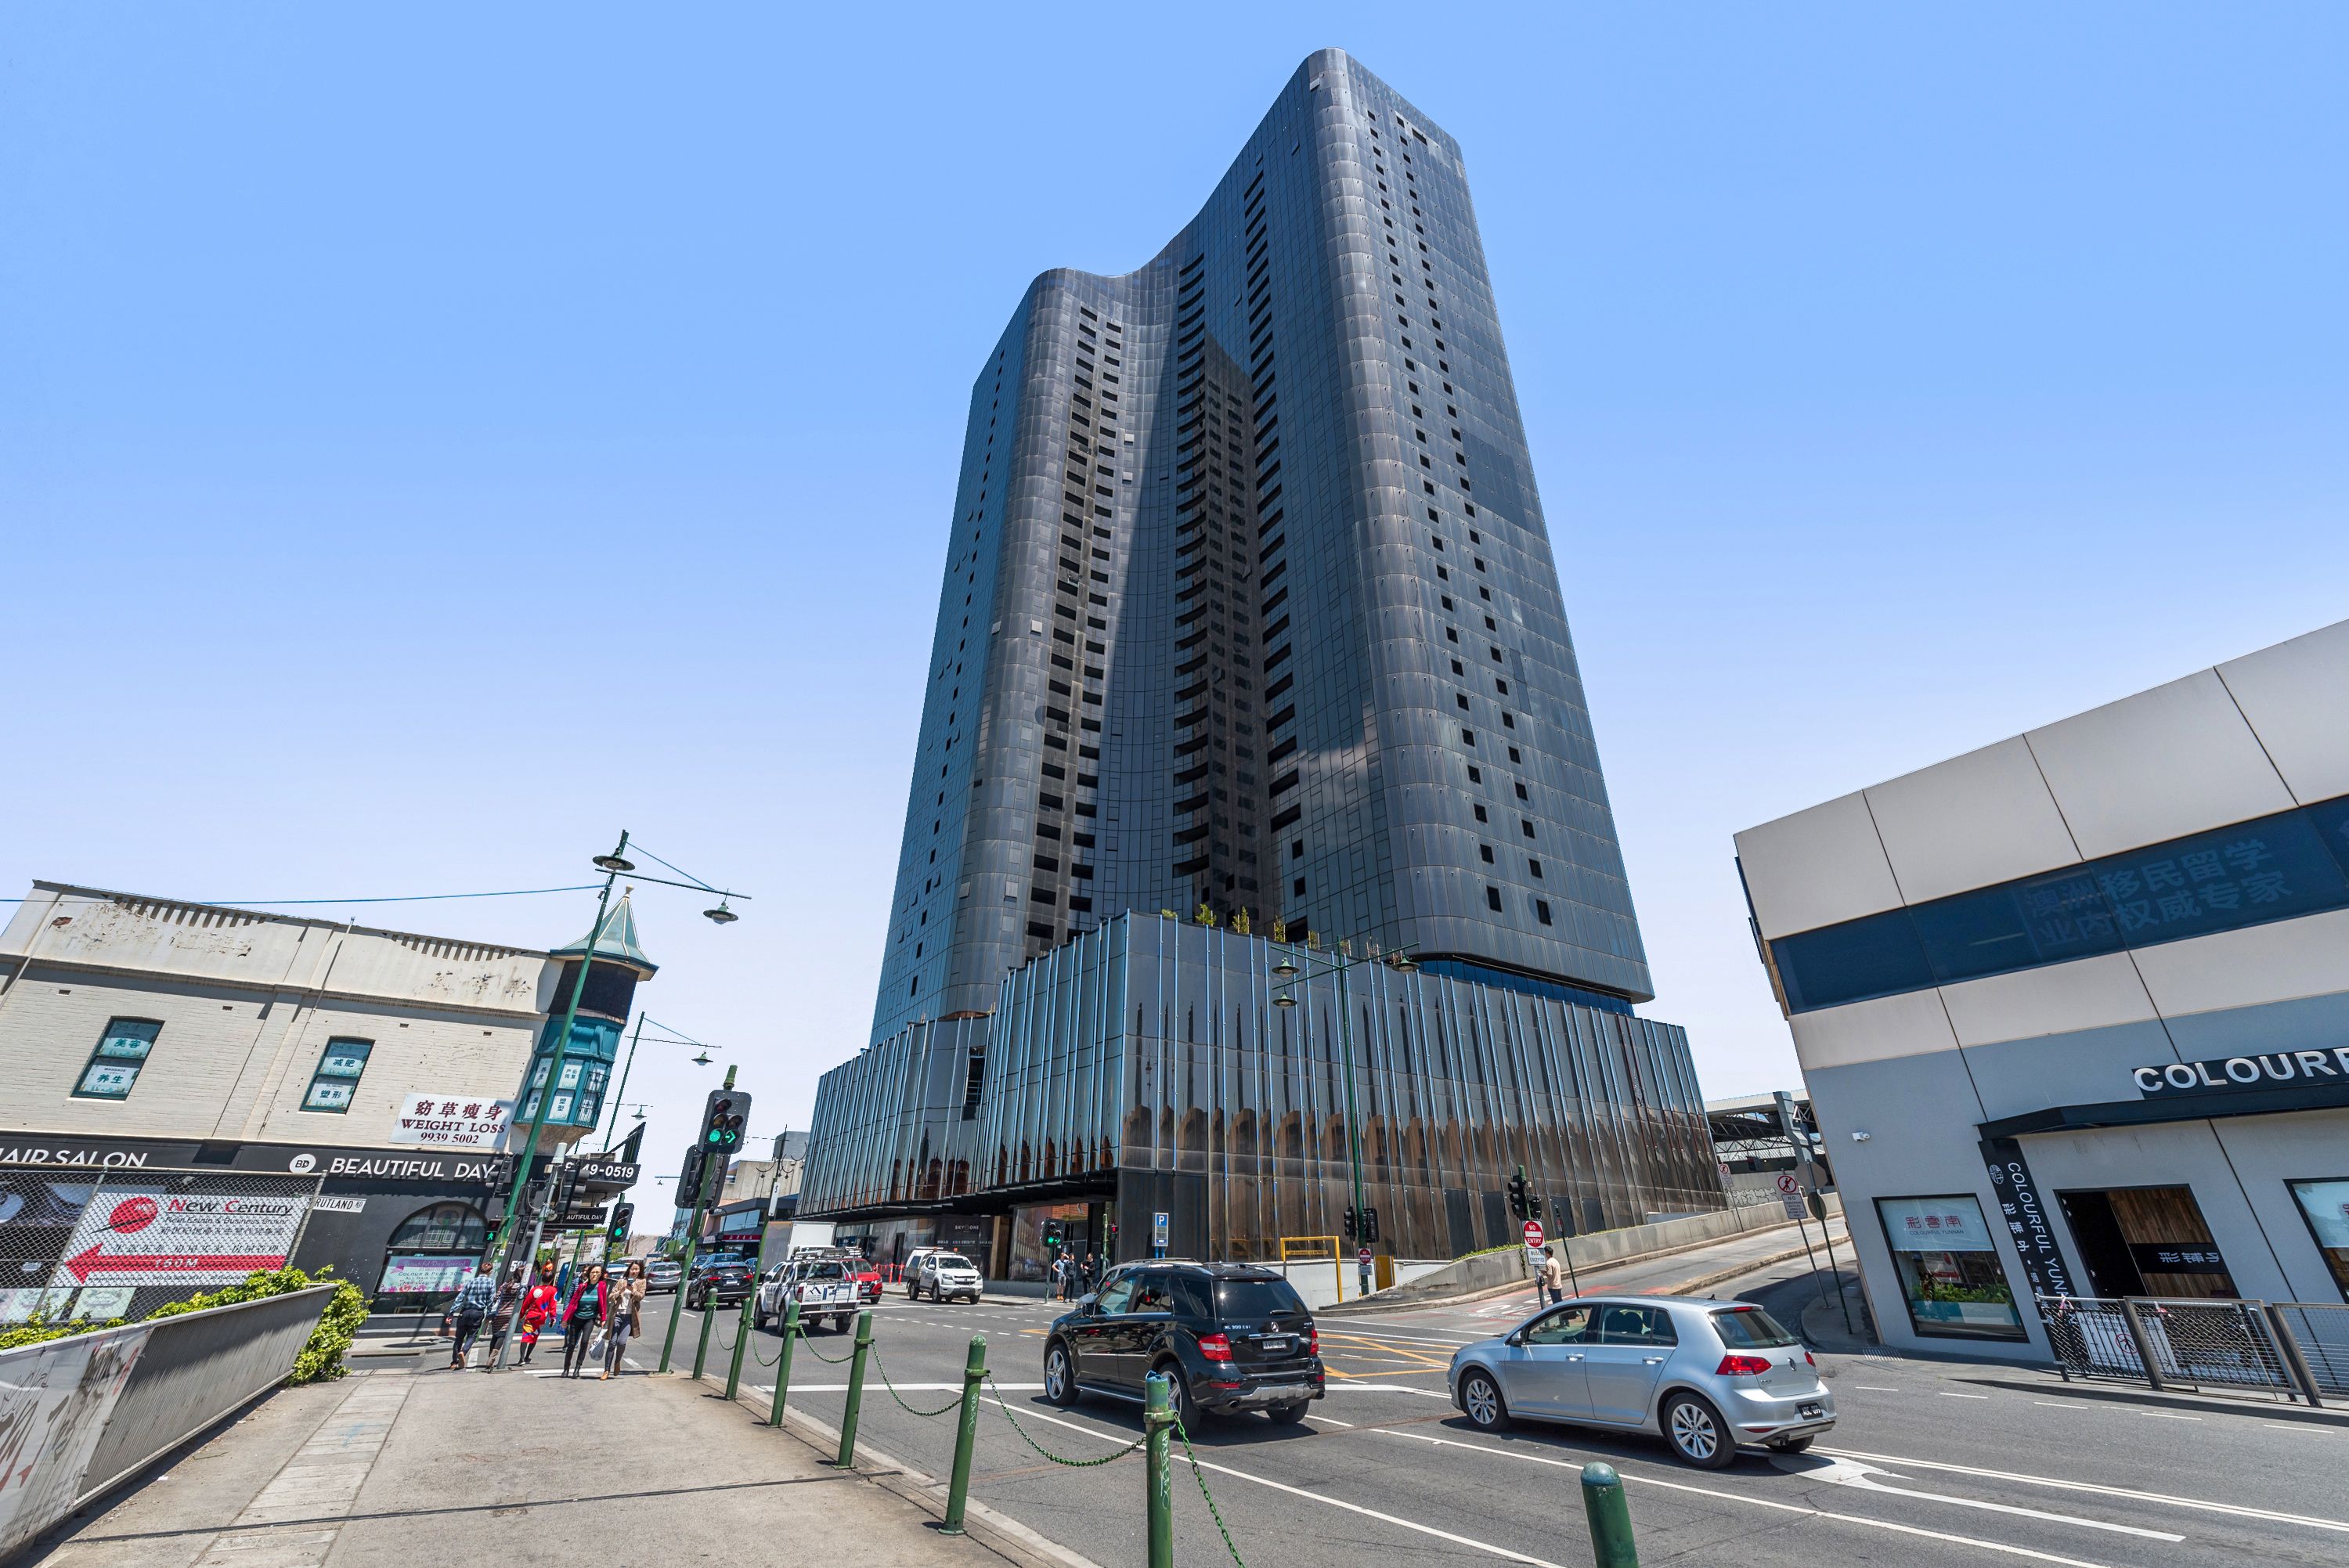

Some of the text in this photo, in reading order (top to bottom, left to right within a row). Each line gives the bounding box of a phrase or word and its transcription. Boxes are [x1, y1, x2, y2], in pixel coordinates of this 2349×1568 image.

[2030, 838, 2272, 918] 澳洲移民留学
[2037, 871, 2293, 940] 业内权威专家
[114, 1038, 141, 1048] 美容
[333, 1058, 355, 1068] 减肥
[97, 1073, 124, 1084] 养生
[319, 1090, 342, 1099] 塑形
[402, 1119, 506, 1134] WEIGHT LOSS
[420, 1132, 479, 1144] 9939 5002
[0, 1148, 148, 1167] AIR SALON
[295, 1159, 310, 1168] BD
[330, 1158, 497, 1179] BEAUTIFUL DAY
[168, 1199, 218, 1212] New
[225, 1200, 294, 1216] Century
[314, 1199, 354, 1209] RUTLAND
[2008, 1162, 2051, 1253] COLOURFUL
[1159, 1216, 1164, 1225] P
[1905, 1214, 1961, 1229] 彩雲南
